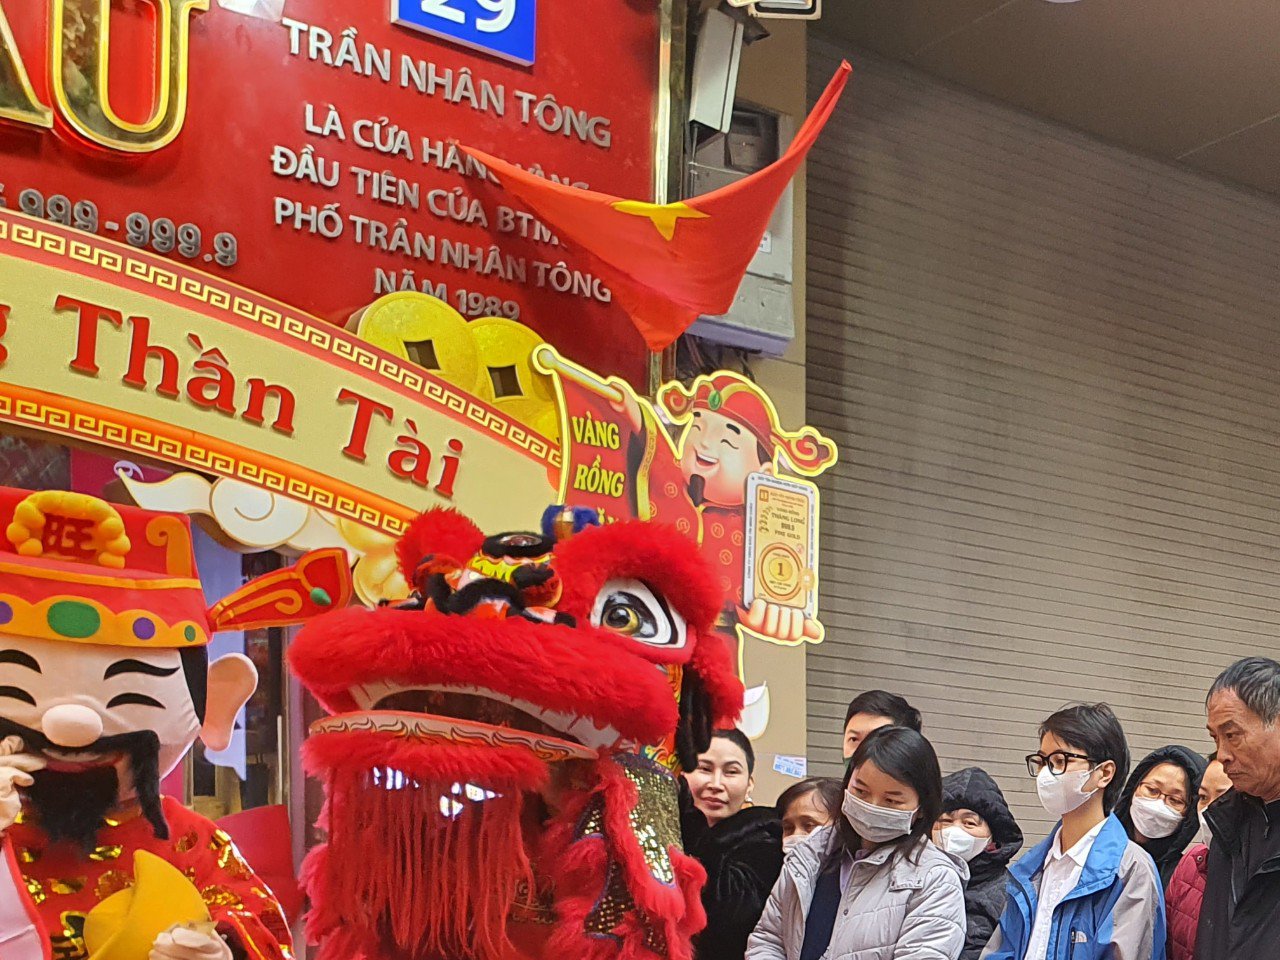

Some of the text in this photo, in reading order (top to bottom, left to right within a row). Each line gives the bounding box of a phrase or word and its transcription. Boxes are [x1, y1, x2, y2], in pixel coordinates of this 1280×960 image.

[282, 17, 612, 148] TRẦN NHÂN TÔNG
[304, 103, 346, 140] LÀ
[352, 116, 414, 160] CỬA
[422, 137, 503, 185] HÀN
[271, 144, 340, 187] ĐẦU
[350, 165, 420, 209] TIÊN
[427, 187, 488, 228] CỦA
[273, 196, 612, 303] PHỐ TRẦN NHÂN TÔNG
[456, 288, 521, 320] 1989
[55, 294, 296, 437] Thần
[337, 387, 465, 498] Tài
[572, 411, 620, 450] VÀNG
[573, 455, 625, 498] RỒNG
